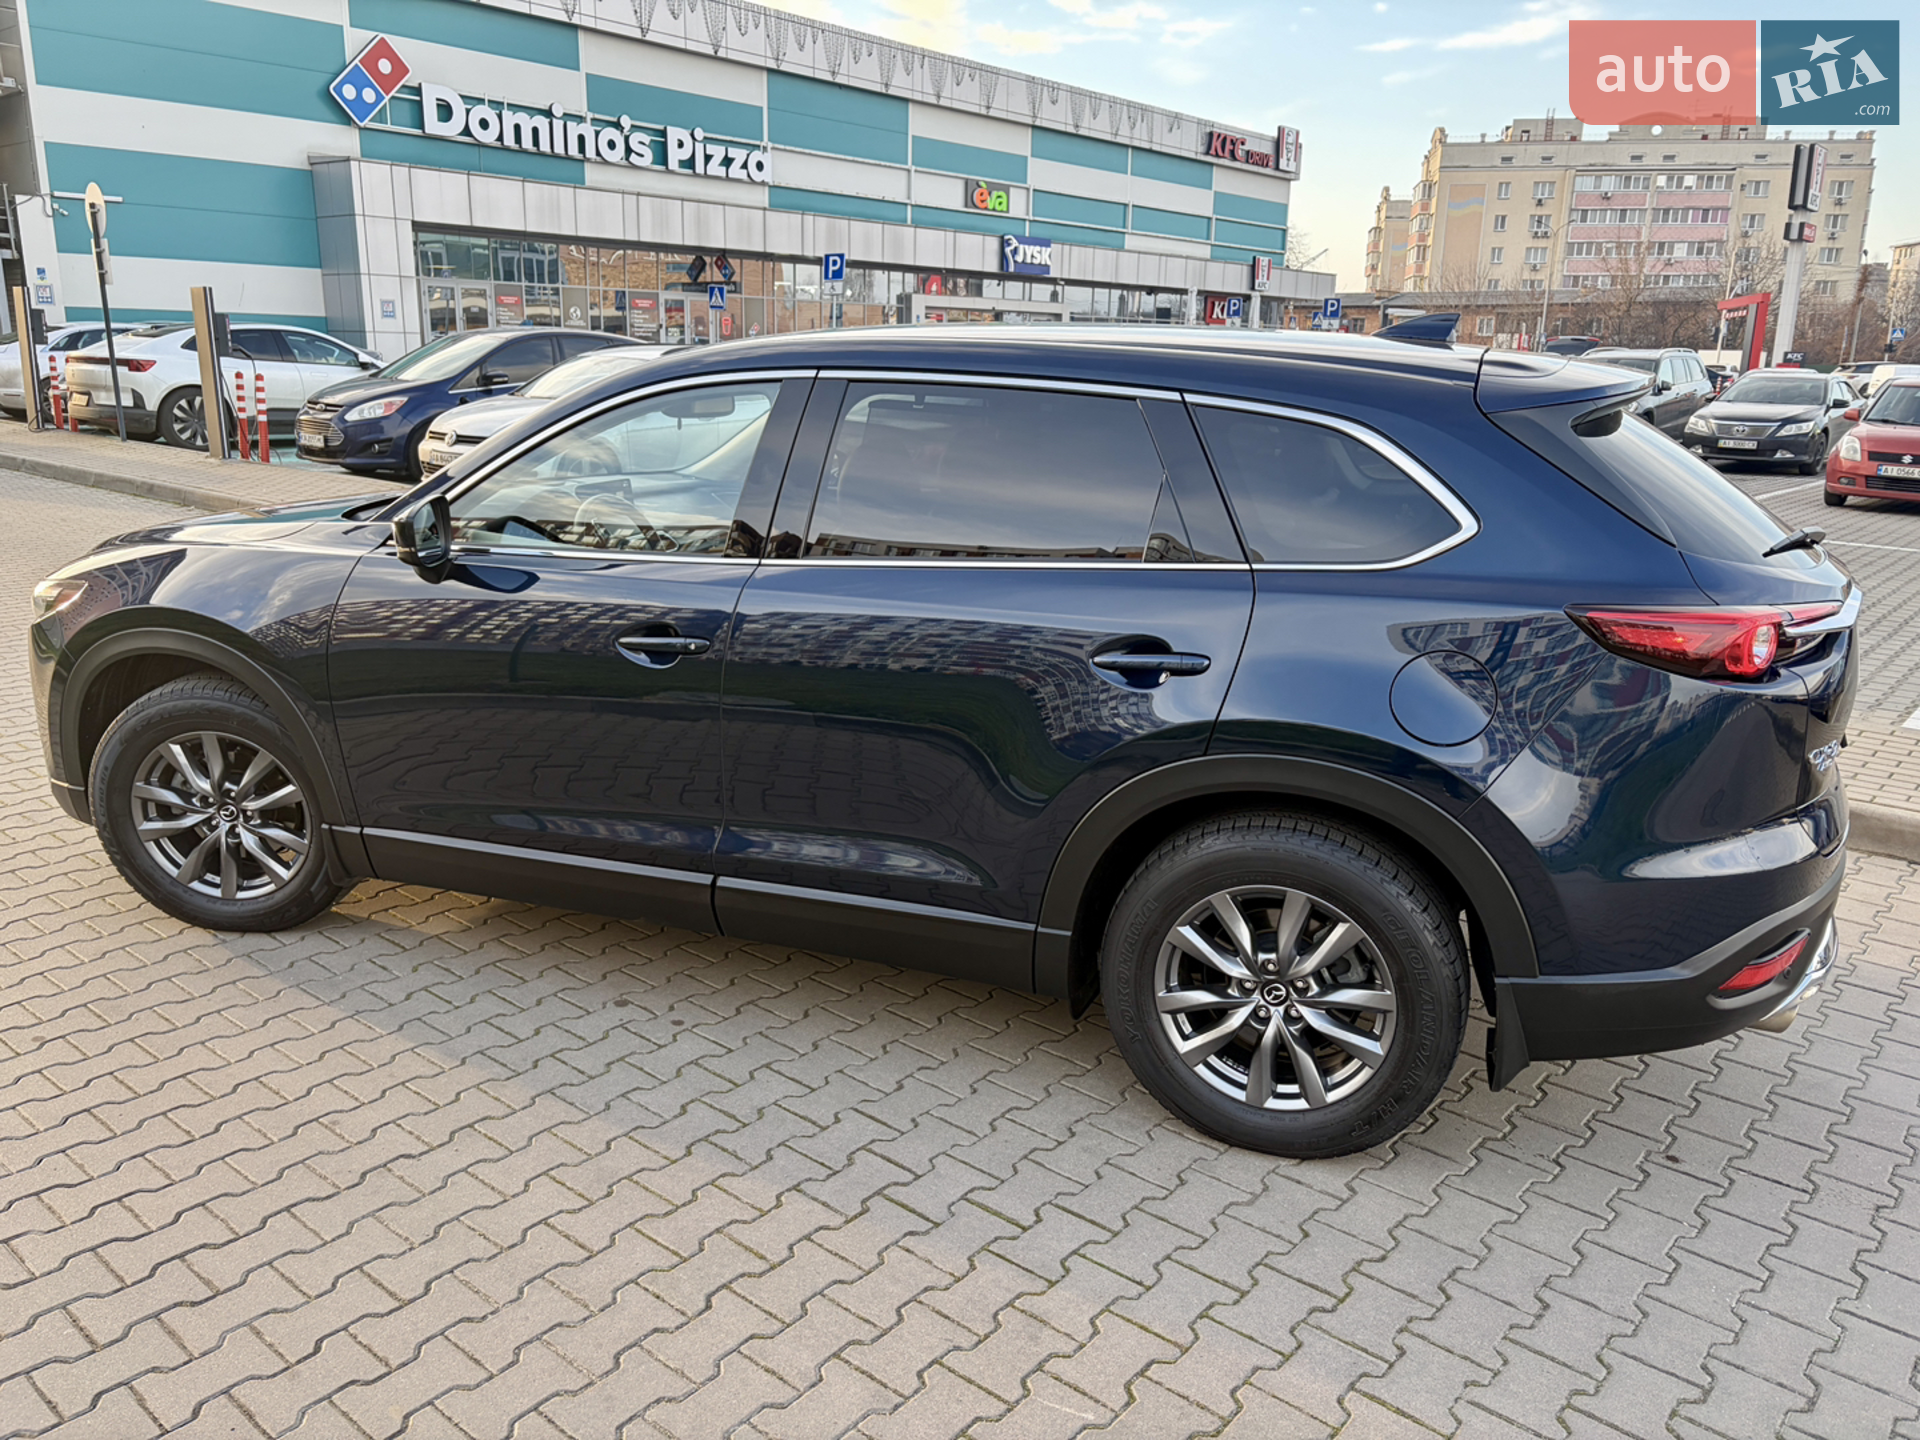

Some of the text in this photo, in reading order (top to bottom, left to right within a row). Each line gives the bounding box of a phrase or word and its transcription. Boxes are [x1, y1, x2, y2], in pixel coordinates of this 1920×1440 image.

[421, 82, 773, 184] Domino's Pizza
[1209, 131, 1275, 169] KFC DRIVE
[828, 255, 842, 279] P
[1015, 244, 1052, 266] JYSK
[1229, 299, 1240, 316] P
[1326, 299, 1339, 317] P
[1786, 352, 1804, 361] KFC
[1117, 898, 1159, 1043] YOKOHAMA
[1351, 911, 1436, 1138] GEOLANDAR H/T
